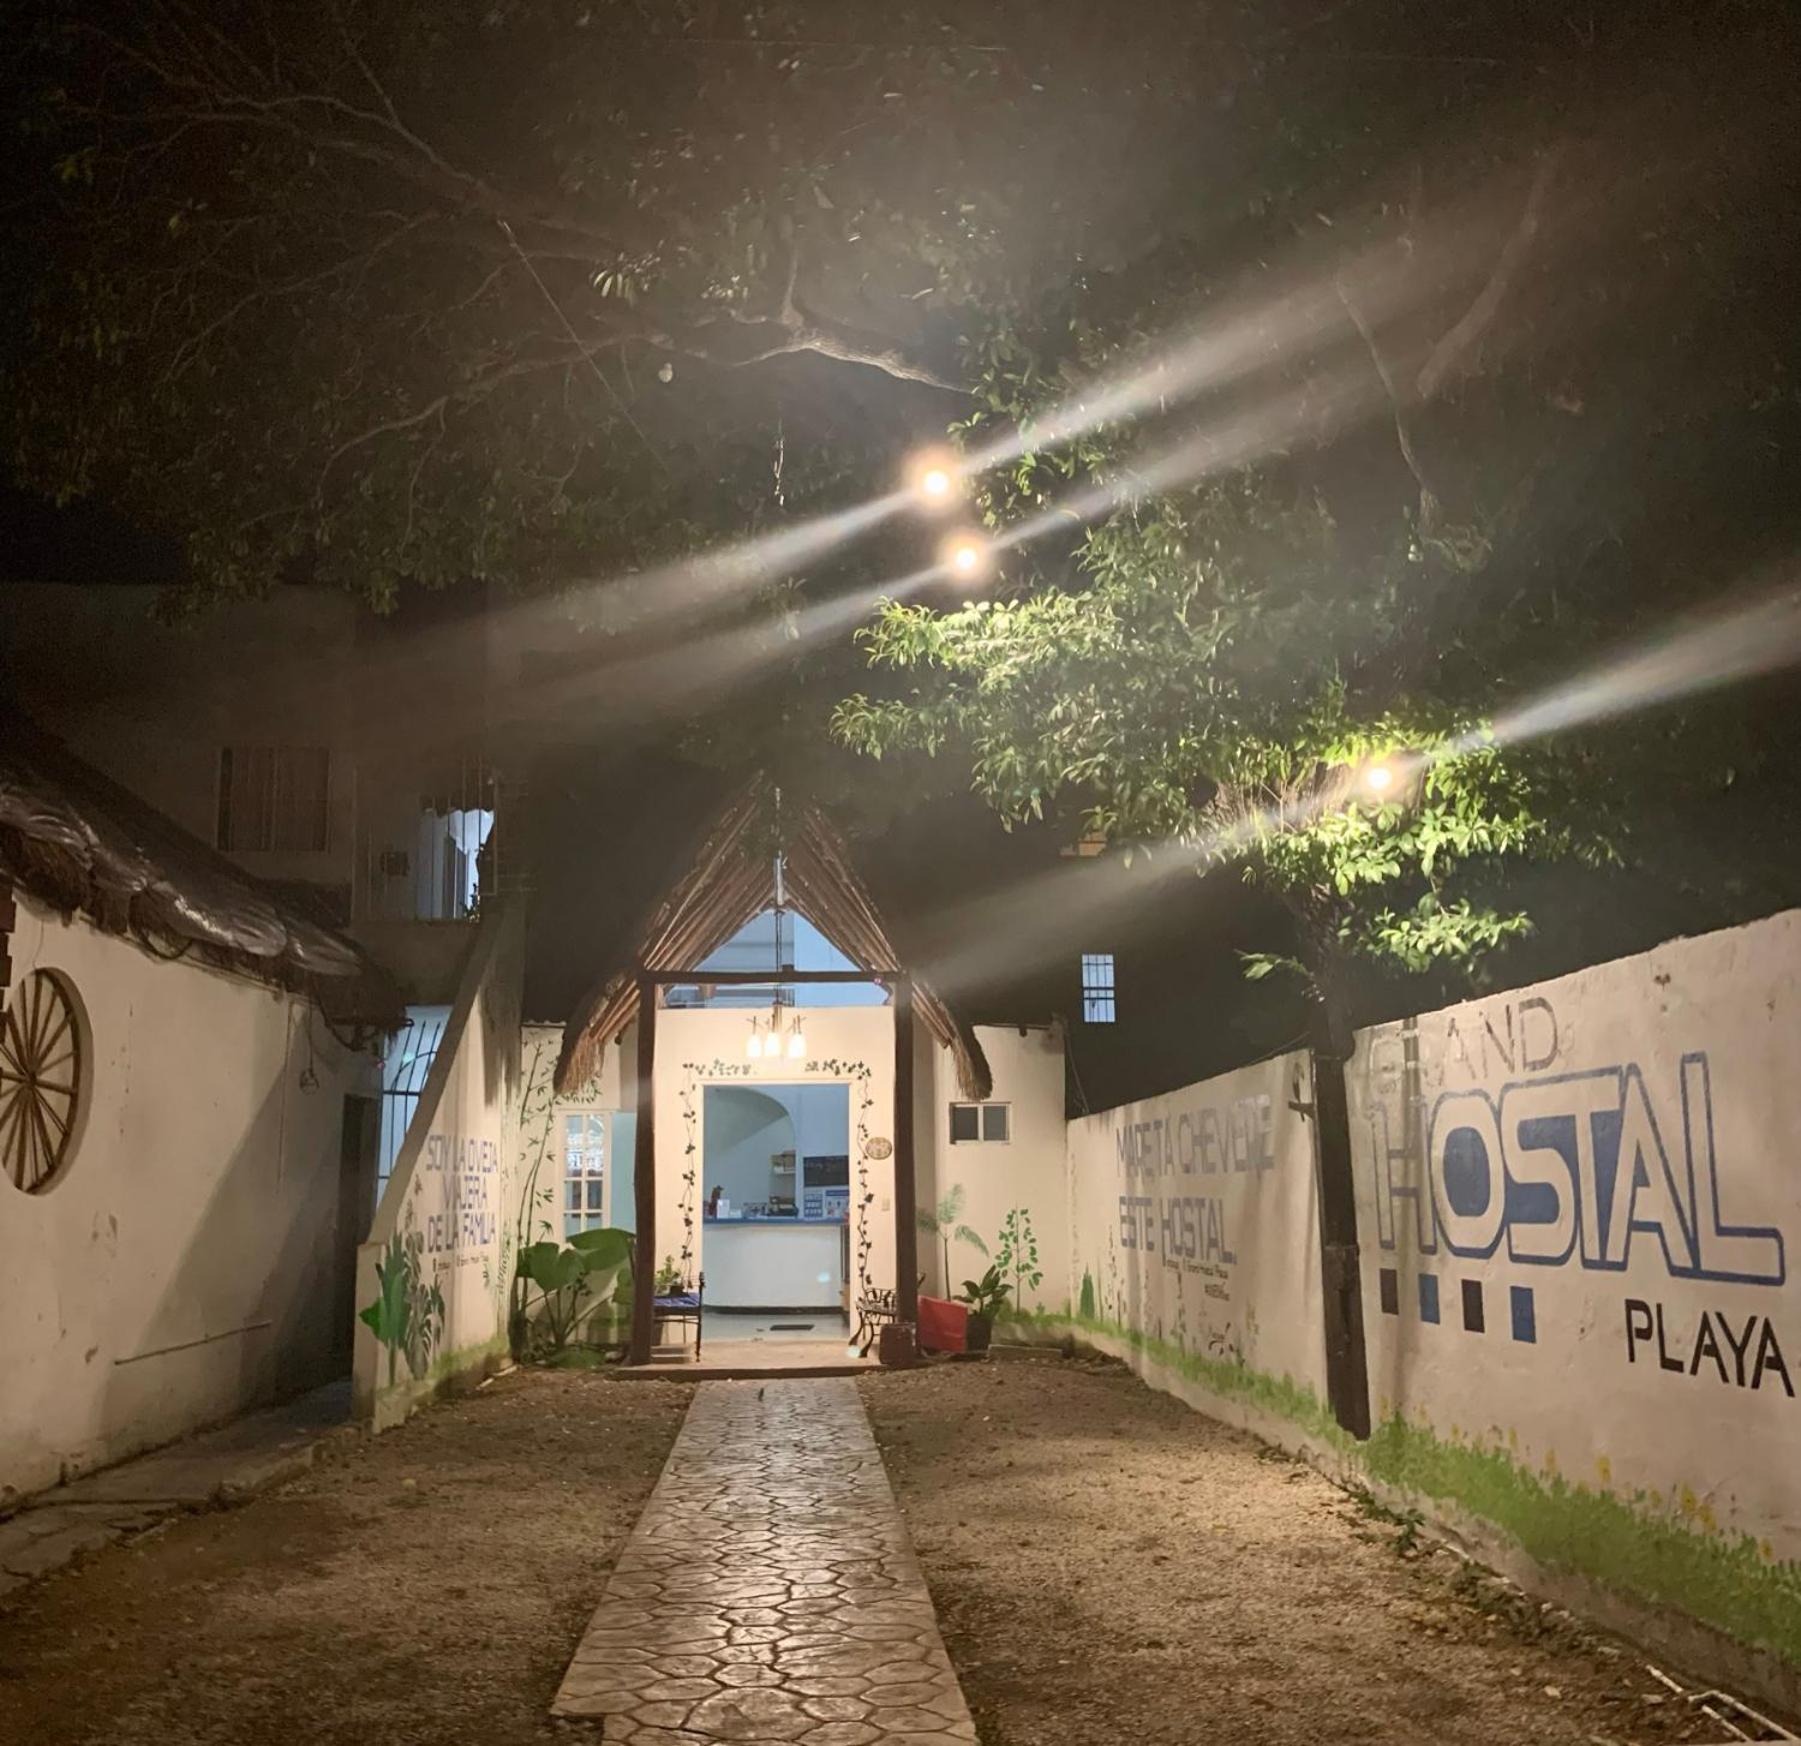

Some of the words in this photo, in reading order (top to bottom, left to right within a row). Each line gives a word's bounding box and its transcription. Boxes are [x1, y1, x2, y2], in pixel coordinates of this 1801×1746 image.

[425, 1135, 451, 1171] SOY
[468, 1138, 498, 1173] OVEJA
[1370, 1050, 1785, 1285] HOSTAL
[427, 1214, 443, 1253] DE
[445, 1213, 459, 1250] LA
[1119, 1195, 1155, 1252] ESTE
[1624, 1298, 1796, 1398] PLAYA
